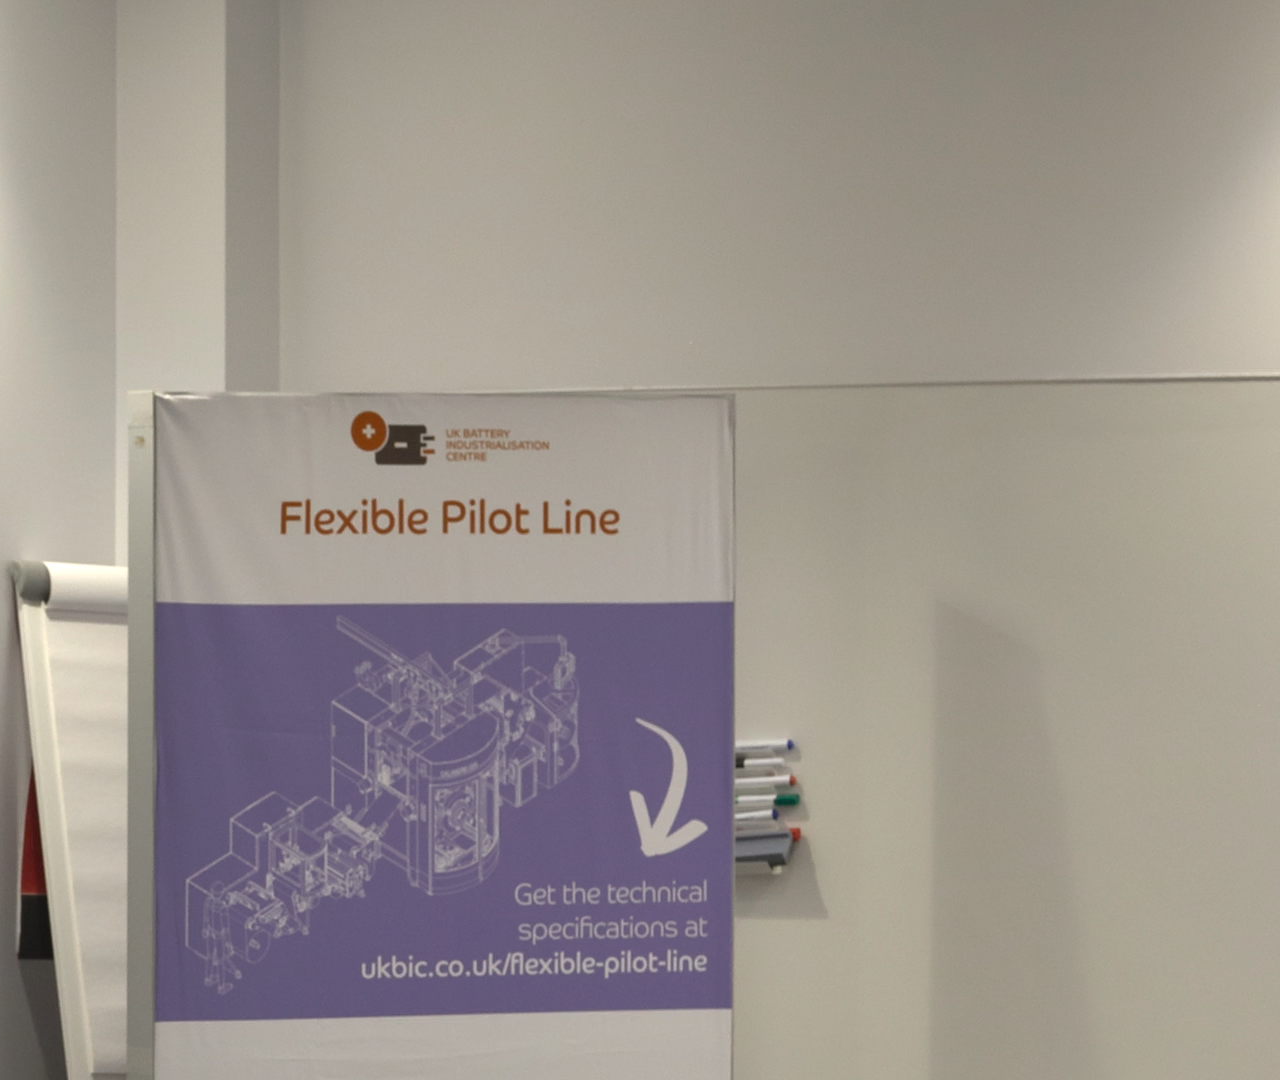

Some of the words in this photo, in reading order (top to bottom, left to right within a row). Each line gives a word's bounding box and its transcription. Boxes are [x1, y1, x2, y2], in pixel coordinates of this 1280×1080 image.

[445, 428, 461, 439] UK
[463, 428, 511, 439] BATTERY
[446, 440, 550, 451] INDUSTRIALISATION
[446, 451, 487, 462] CENTRE
[280, 498, 429, 536] Flexible
[442, 498, 530, 536] Pilot
[542, 498, 621, 536] Line
[514, 882, 556, 906] Get
[562, 881, 601, 904] the
[608, 879, 708, 904] technical
[518, 915, 679, 945] specifications
[685, 917, 708, 938] at
[361, 950, 708, 979] ukbic.co.uk/flexible-pilot-line
